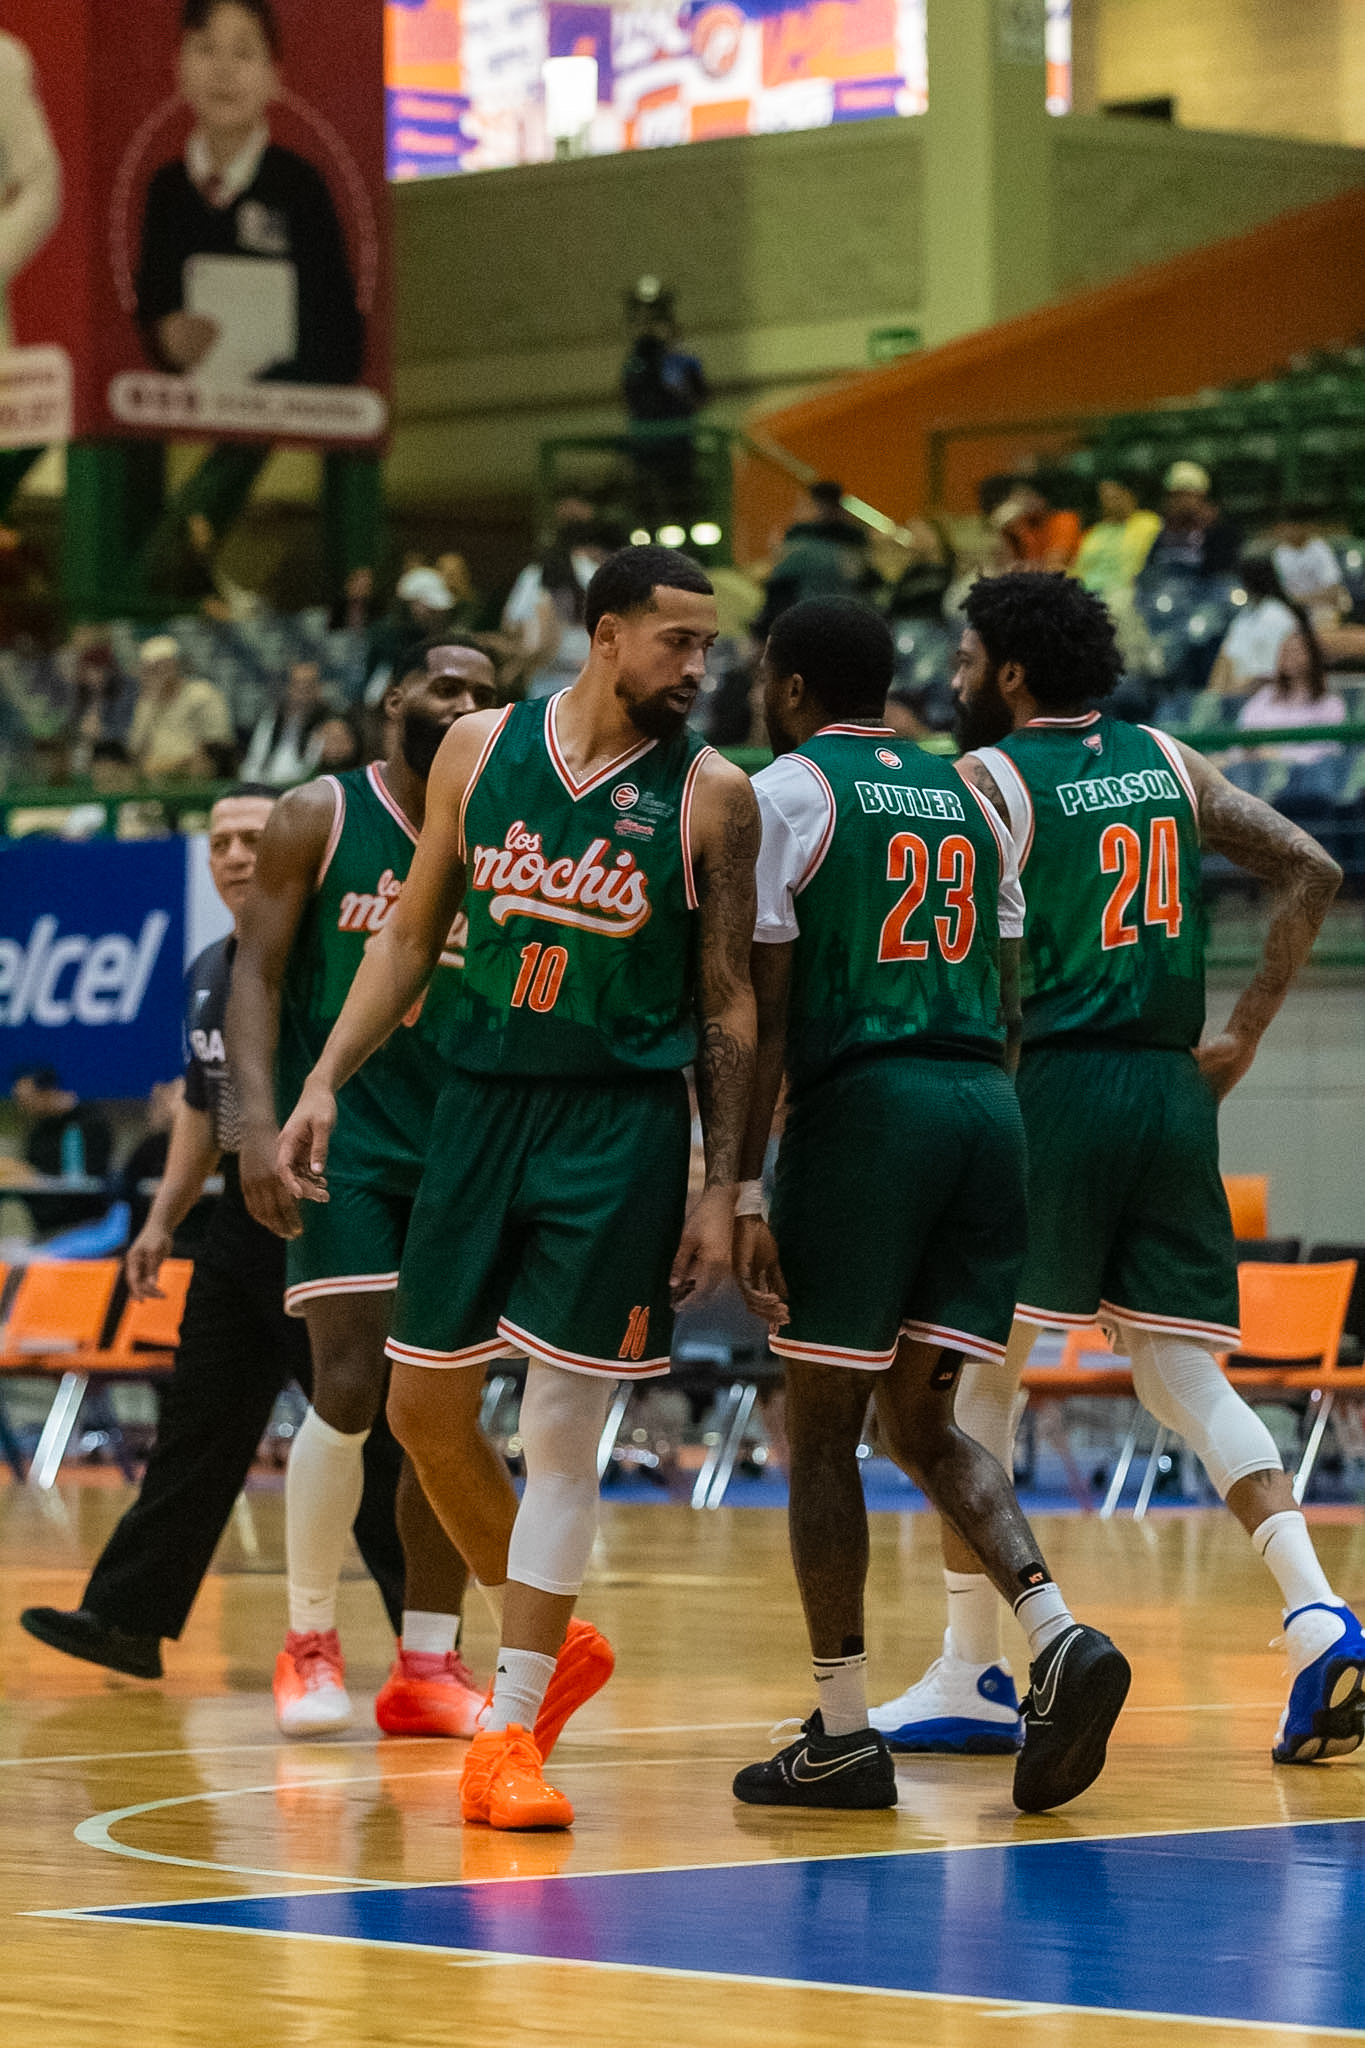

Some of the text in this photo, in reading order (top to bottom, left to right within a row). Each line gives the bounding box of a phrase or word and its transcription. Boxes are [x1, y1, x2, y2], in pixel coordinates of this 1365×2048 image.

[855, 781, 966, 821] BUTLER
[1056, 769, 1181, 816] PEARSON
[503, 819, 543, 851] los
[377, 868, 402, 897] lo
[473, 838, 649, 919] mochis
[877, 832, 976, 964] 23
[1100, 816, 1182, 951] 24
[510, 941, 569, 1013] 10
